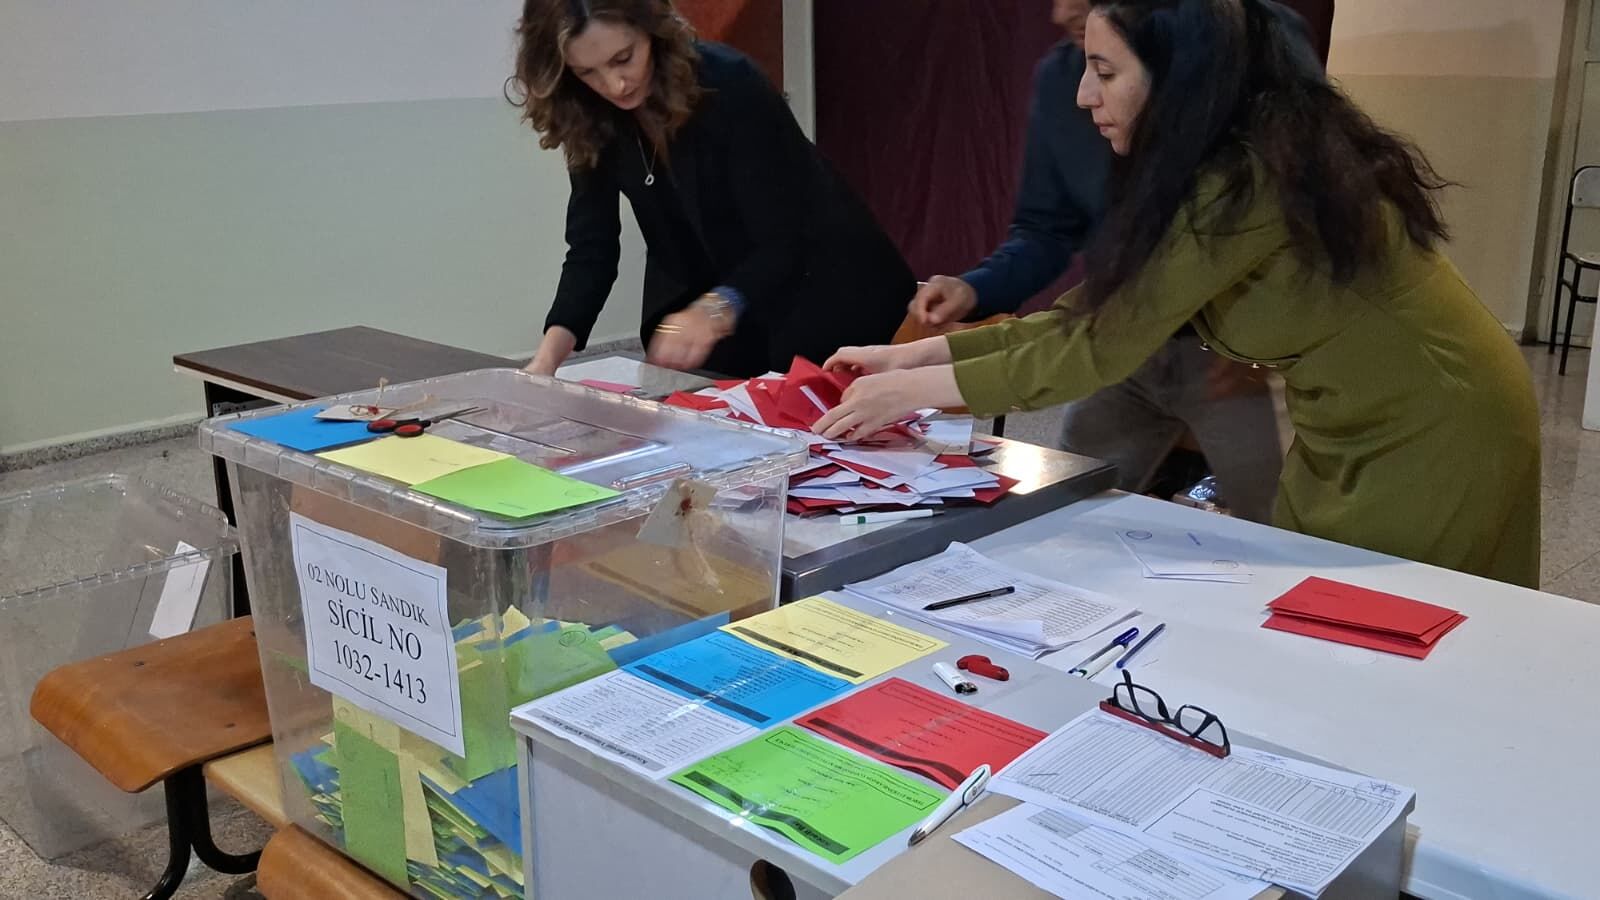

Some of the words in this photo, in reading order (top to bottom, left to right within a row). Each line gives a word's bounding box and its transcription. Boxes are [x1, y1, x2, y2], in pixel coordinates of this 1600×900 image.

[307, 563, 323, 583] 02
[324, 569, 366, 599] NOLU
[370, 586, 430, 627] SANDIK
[328, 599, 383, 645] SİCİL
[388, 623, 422, 660] NO
[334, 640, 427, 704] 1032-1413
